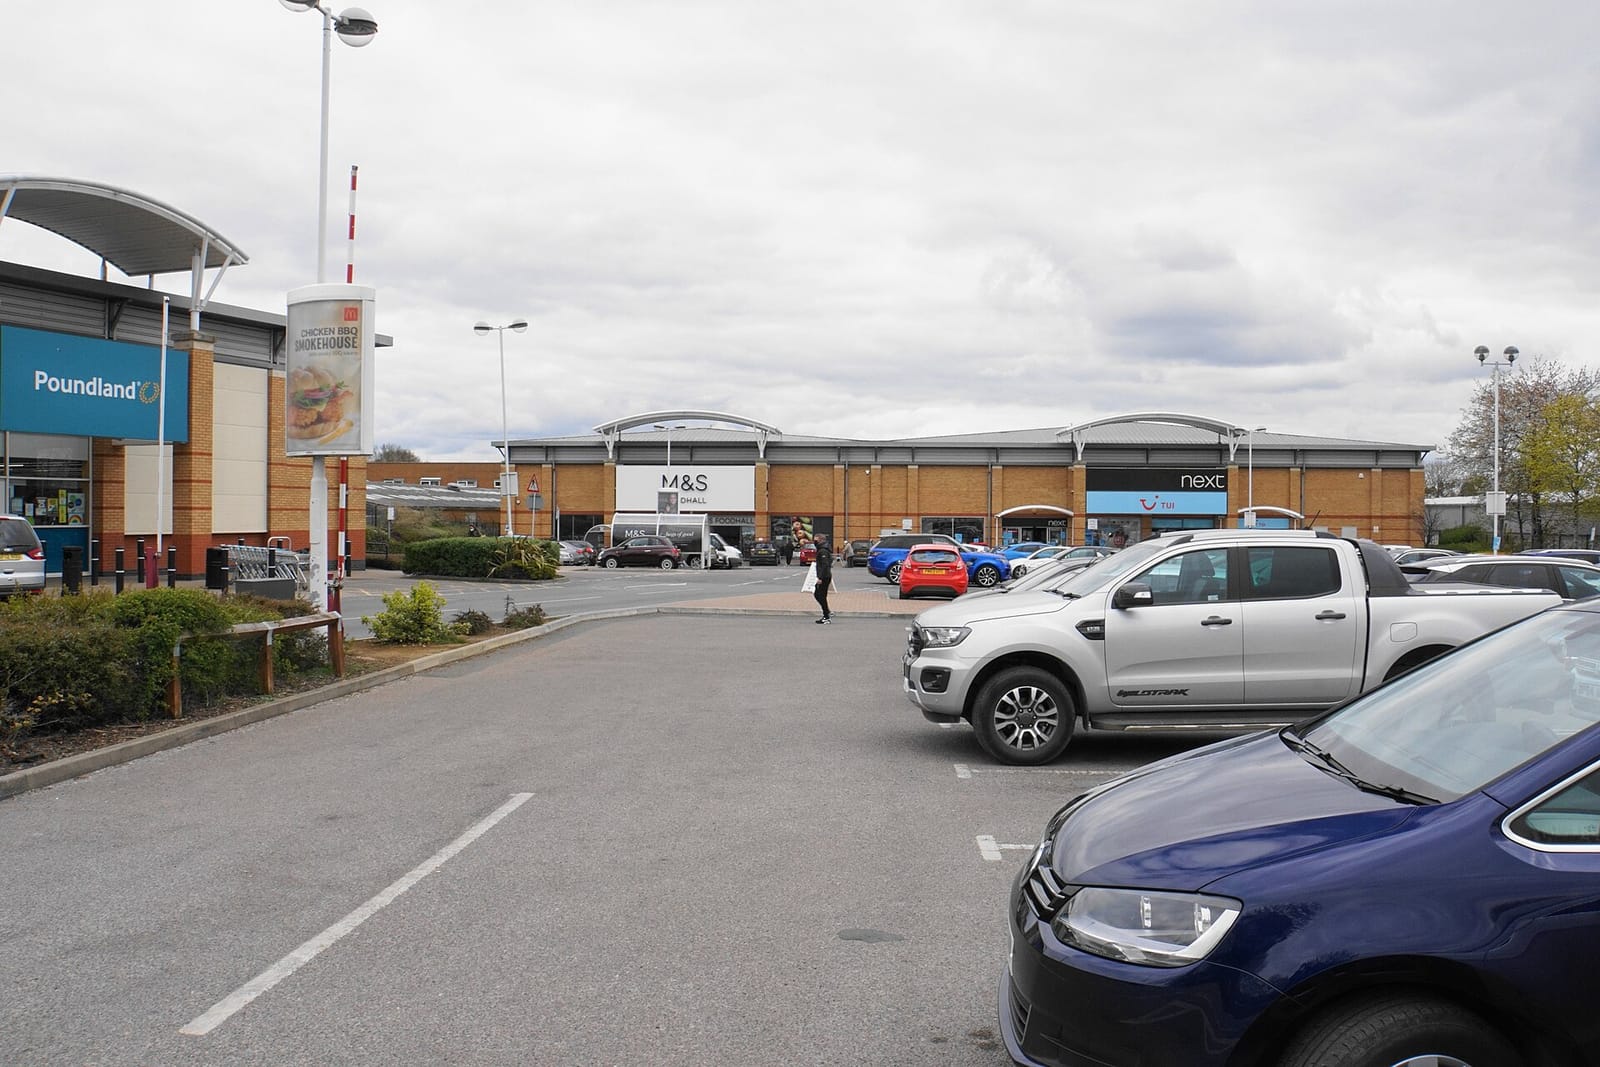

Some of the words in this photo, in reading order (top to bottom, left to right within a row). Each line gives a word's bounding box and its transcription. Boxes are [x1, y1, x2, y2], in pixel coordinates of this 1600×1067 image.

[301, 327, 335, 337] CHICKEN
[337, 326, 358, 336] BBQ
[295, 336, 358, 352] SMOKEHOUSE
[34, 370, 136, 400] Poundland
[662, 474, 708, 491] M&S
[1181, 474, 1225, 488] next
[717, 516, 754, 525] FOODHALL
[625, 529, 646, 538] M&S
